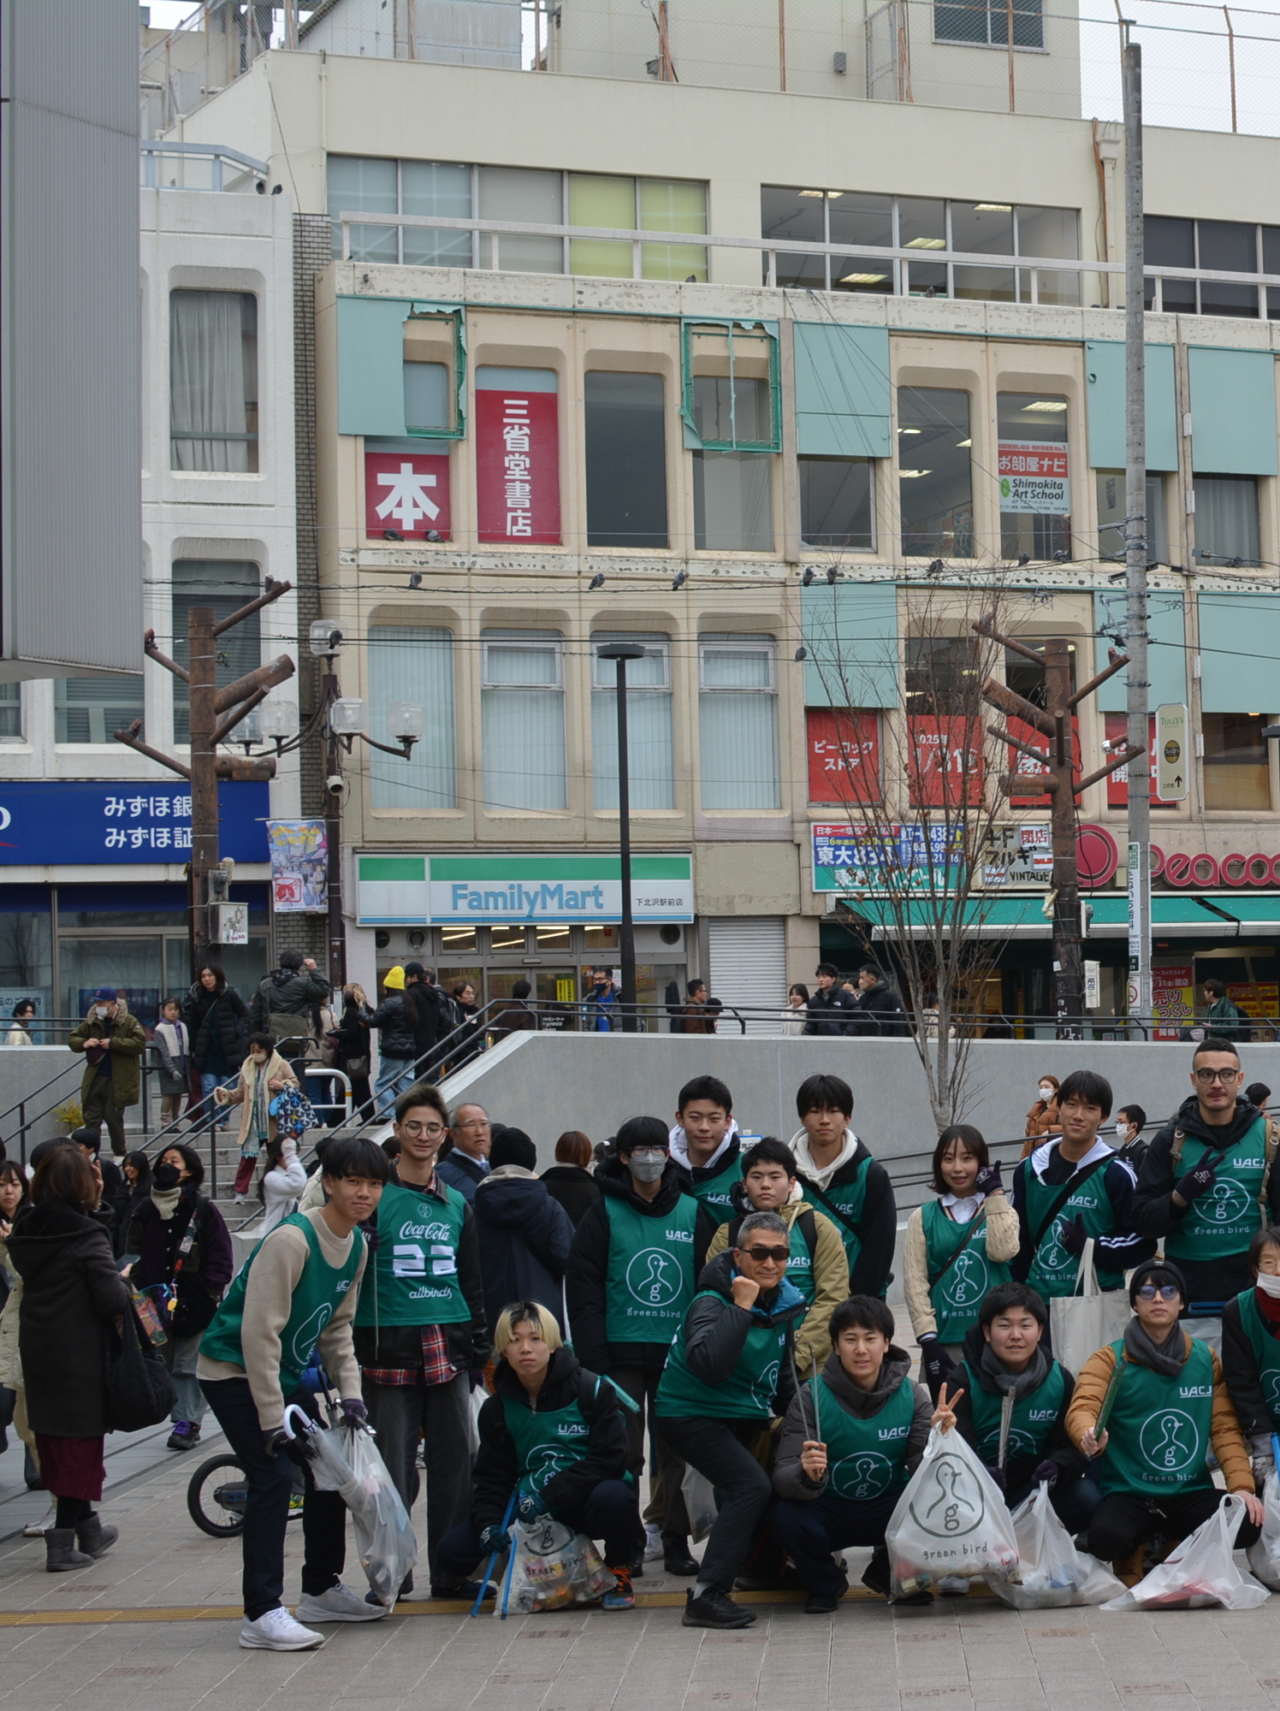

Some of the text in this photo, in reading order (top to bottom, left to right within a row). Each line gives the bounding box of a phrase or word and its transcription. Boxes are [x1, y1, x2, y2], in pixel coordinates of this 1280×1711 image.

[501, 397, 533, 538] 三省堂書店
[999, 455, 1066, 473] お部屋ナビ
[1012, 478, 1064, 490] Shimokita
[375, 461, 441, 531] 本
[1012, 489, 1065, 501] Art School
[814, 740, 874, 755] ピーコック
[824, 757, 860, 771] ストア
[985, 845, 1038, 866] フルギ
[1009, 871, 1050, 882] VINTAGE
[451, 883, 605, 918] FamilyMart
[635, 897, 684, 908] 下北沢駅前店
[1153, 989, 1182, 1008] 売り
[1157, 1003, 1193, 1018] つくし
[1233, 1158, 1266, 1169] UACJ
[706, 1191, 733, 1205] UAC
[1066, 1195, 1098, 1208] UACJ
[666, 1229, 695, 1242] UACJ
[1194, 1225, 1250, 1237] green bird
[408, 1285, 453, 1300] allbirds
[626, 1306, 682, 1319] green bird
[1179, 1384, 1213, 1398] UACJ
[1029, 1408, 1059, 1421] UACJ
[877, 1426, 911, 1440] UACJ
[1142, 1472, 1175, 1483] green
[923, 1541, 989, 1561] green bird
[525, 1557, 583, 1576] green bir
